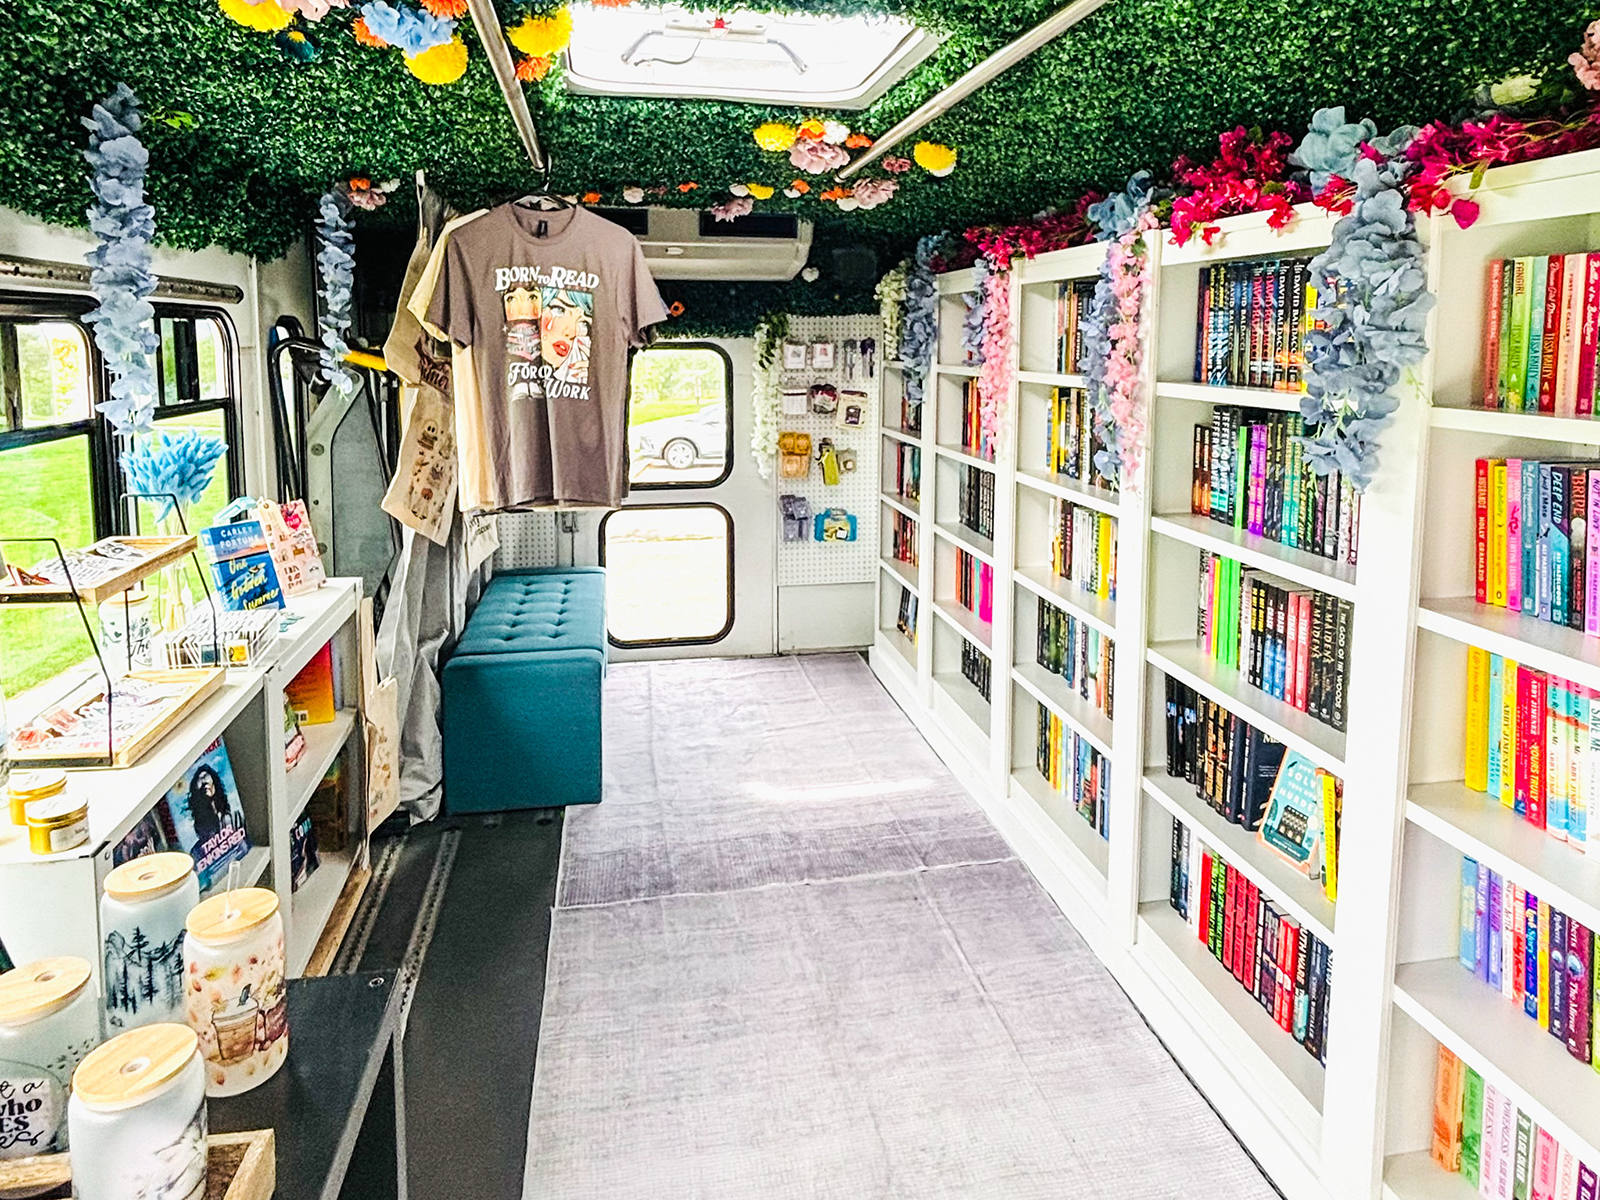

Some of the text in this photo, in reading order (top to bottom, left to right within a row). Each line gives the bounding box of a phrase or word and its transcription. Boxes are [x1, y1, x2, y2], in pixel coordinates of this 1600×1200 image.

[494, 265, 600, 292] BORN TO READ
[1515, 261, 1525, 297] FANGIRL
[1549, 261, 1560, 287] Dream
[1252, 275, 1262, 309] DAVID
[1264, 275, 1275, 309] DAVID
[1239, 308, 1247, 351] BALDACCI
[1276, 275, 1287, 362] DAVID BALDACCI
[1290, 275, 1301, 364] DAVID BALDACCI
[1546, 302, 1556, 329] Drama
[1512, 324, 1522, 345] TESSA
[1529, 334, 1541, 354] TESSA
[1510, 345, 1522, 369] BAILEY
[1528, 354, 1540, 380] BAILEY
[1541, 332, 1555, 380] TESSA BAILEY
[544, 378, 592, 400] WORK
[1210, 409, 1221, 489] JEFFERY DEAVER
[1219, 410, 1230, 491] JEFFERY DEAVER
[1227, 497, 1235, 517] ELLIS
[1495, 469, 1505, 518] bad publicity
[1552, 470, 1564, 525] DEEP END
[1570, 472, 1586, 517] BRIDE
[219, 533, 260, 549] FORTUNE
[220, 525, 253, 537] CARLEY
[1496, 534, 1504, 561] bianca
[229, 559, 248, 575] One
[1477, 541, 1485, 582] GRAMAZIO
[1509, 564, 1517, 591] LESSONS
[1540, 556, 1548, 599] HAZELWOOD
[1591, 560, 1599, 572] ALI
[1200, 608, 1208, 638] NEVER
[1266, 606, 1274, 630] CRASH
[1276, 610, 1285, 635] CRASH
[1310, 607, 1323, 660] MAIDENS
[1322, 596, 1335, 664] THE MAIDENS
[1338, 625, 1346, 647] GOD
[1335, 674, 1343, 709] WOODS
[1529, 679, 1538, 736] ABBY JIMENEZ
[1501, 701, 1511, 778] ABBY JIMENEZ
[1589, 707, 1600, 753] SAVE ME
[1287, 766, 1317, 790] SOLV
[1529, 745, 1540, 802] YOURS TRULY
[1589, 761, 1597, 785] MONA
[1570, 760, 1578, 823] ABBY JIMENEZ
[201, 823, 234, 852] TAYLOR
[226, 826, 246, 847] REID
[1296, 952, 1307, 986] WARE
[1553, 913, 1563, 1013] Roberts Inheritance
[1568, 918, 1580, 1033] oberts The Mirror
[1308, 1001, 1317, 1040] WHITAKER
[23, 1080, 44, 1094] a
[1497, 1097, 1513, 1198] POWERLESS ELSIE SILVER
[1516, 1130, 1528, 1184] ELSIE SILVER
